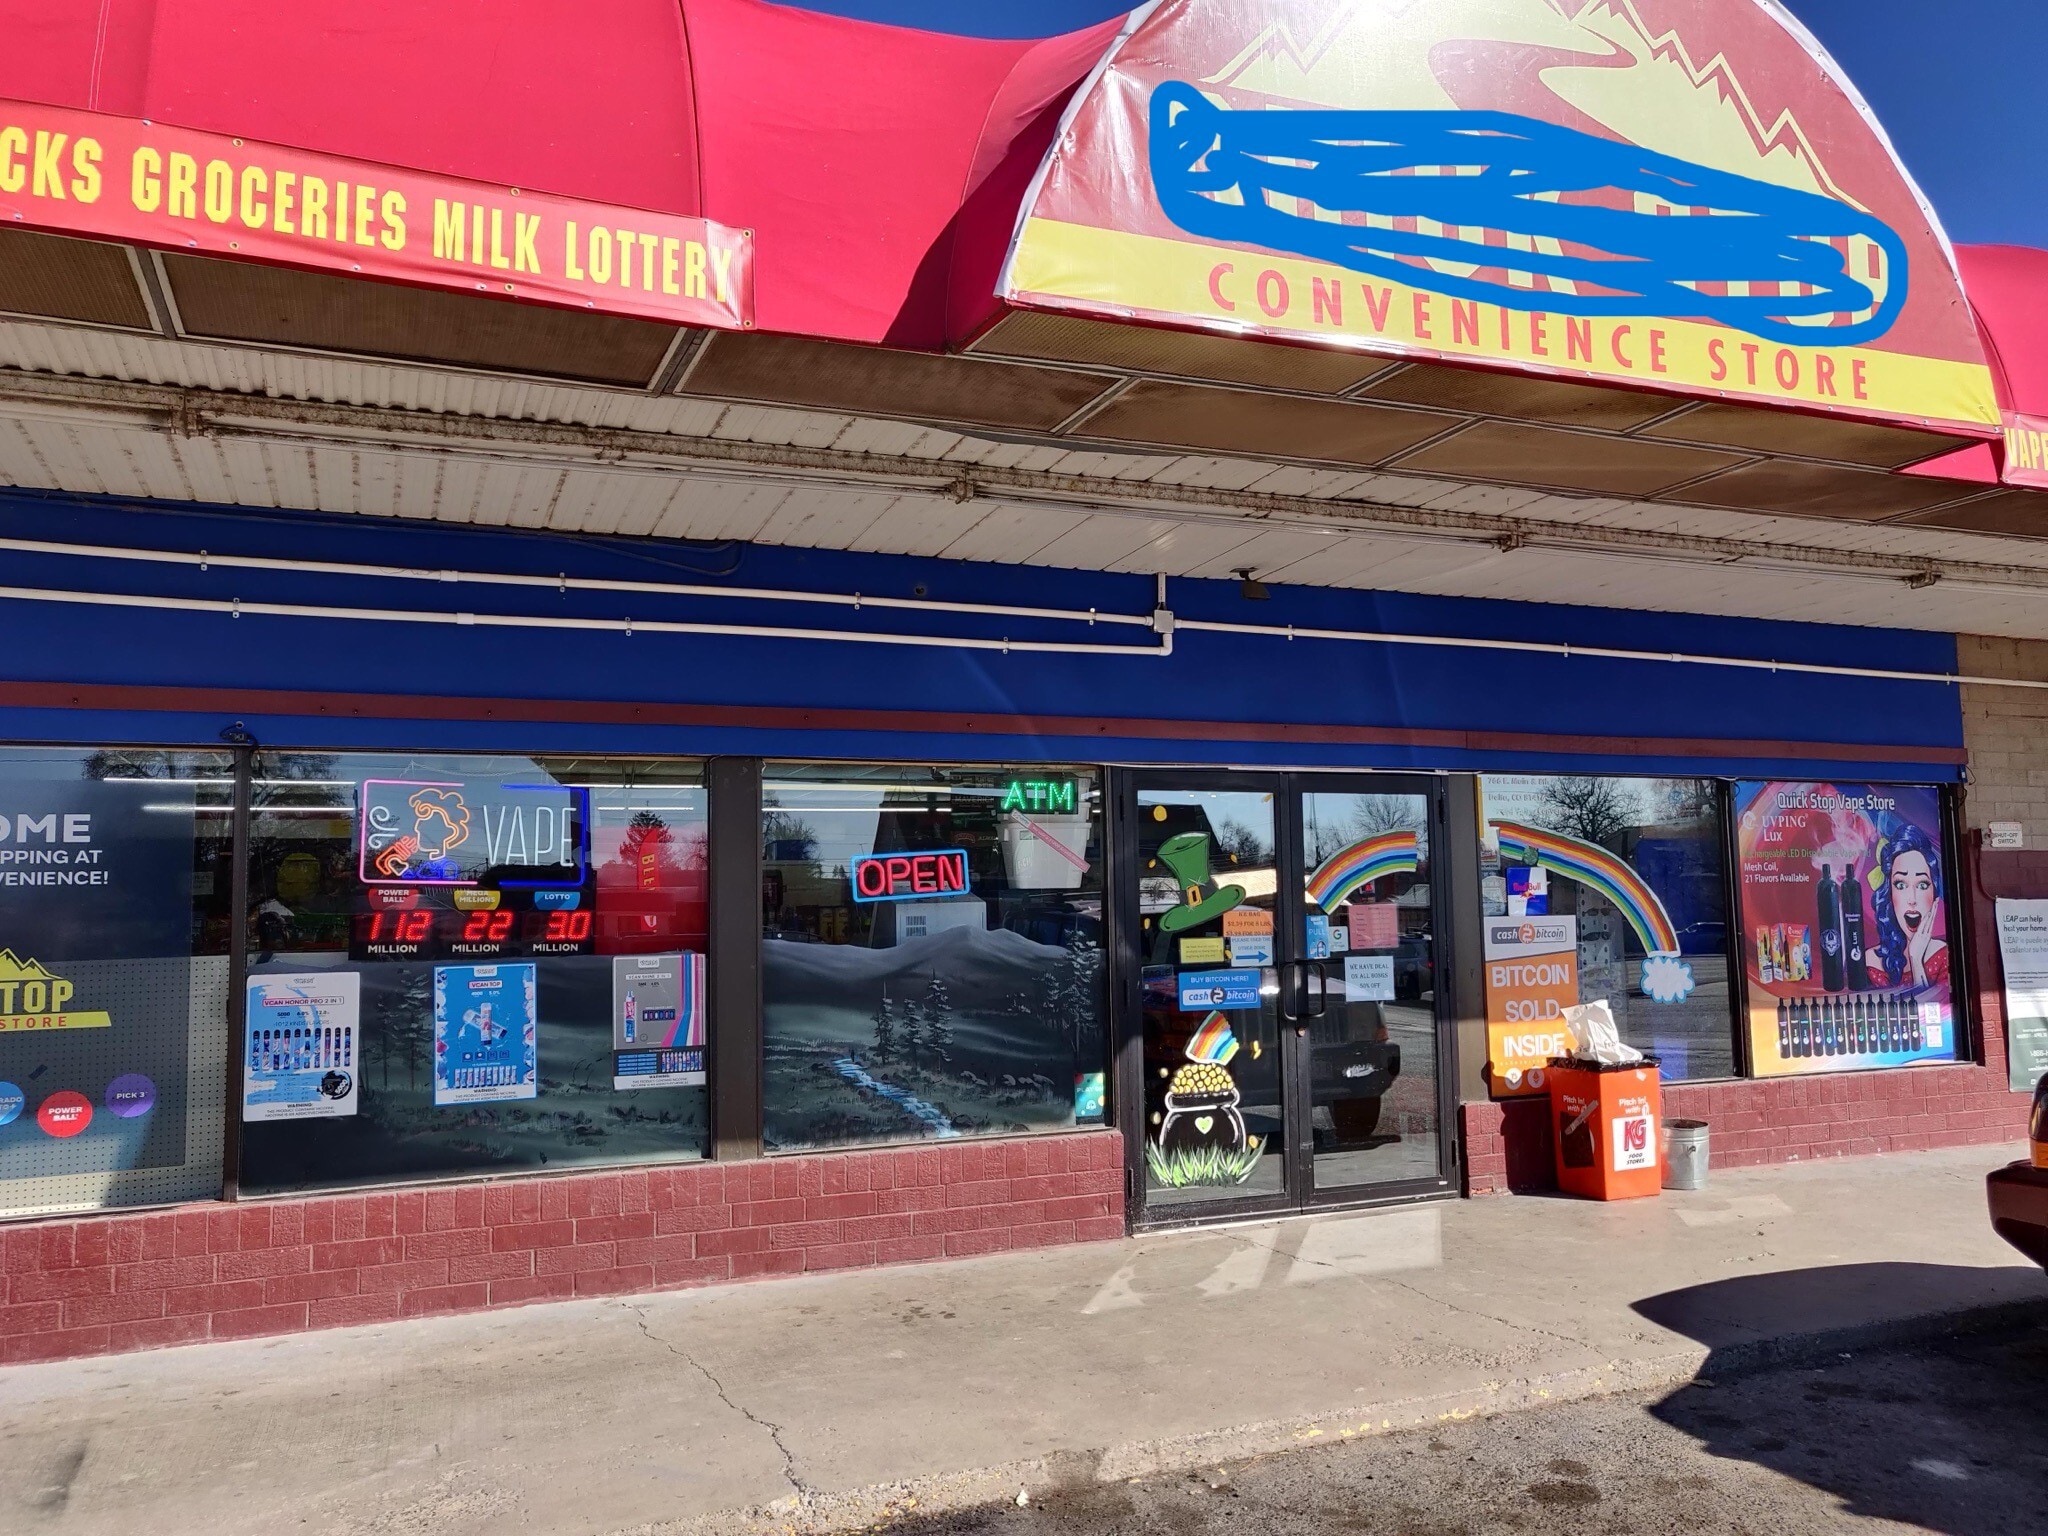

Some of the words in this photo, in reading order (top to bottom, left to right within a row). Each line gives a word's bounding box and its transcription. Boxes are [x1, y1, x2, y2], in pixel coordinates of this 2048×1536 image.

[0, 125, 102, 205] CKS
[132, 145, 407, 251] GROCERIES
[433, 199, 541, 274] MILK
[565, 220, 733, 302] LOTTERY
[1207, 262, 1668, 372] CONVENIENCE
[1710, 338, 1868, 399] STORE
[1003, 780, 1073, 811] ATM
[1777, 792, 1809, 810] Quick
[1810, 793, 1836, 812] Stop
[1837, 794, 1865, 814] Vape
[1867, 794, 1896, 811] Store
[483, 804, 577, 867] VAPE
[1764, 829, 1783, 842] Lux
[74, 850, 103, 864] AT
[1787, 849, 1800, 857] LED
[1744, 863, 1762, 871] Mesh
[1763, 862, 1779, 871] Coil,
[858, 854, 963, 896] OPEN
[1745, 874, 1753, 883] 21
[1754, 874, 1779, 882] Flavors
[1779, 873, 1810, 882] Available
[1512, 882, 1529, 891] Red
[1529, 882, 1542, 891] Bull
[2003, 914, 2019, 922] LEAP
[2029, 914, 2044, 924] help
[370, 911, 432, 941] 112
[464, 910, 513, 941] 22
[546, 910, 592, 941] 30
[2003, 924, 2015, 932] heat
[2016, 926, 2029, 934] your
[2029, 924, 2047, 932] home
[1308, 928, 1326, 936] PULL
[1496, 928, 1518, 940] cash
[1536, 928, 1564, 939] bitcoin
[367, 944, 418, 954] MILLION
[452, 944, 500, 953] MILLION
[532, 943, 579, 952] MILLION
[1491, 963, 1570, 988] BITCOIN
[1188, 991, 1209, 1001] cash
[1226, 990, 1255, 1000] bitcoin
[1505, 998, 1560, 1023] SOLD
[0, 1016, 67, 1030] STORE
[1503, 1033, 1565, 1058] INSIDE
[1562, 1095, 1577, 1104] Pitch
[1619, 1098, 1637, 1107] Pitch
[48, 1106, 83, 1115] POWER
[1567, 1105, 1580, 1113] with
[1625, 1107, 1641, 1115] with
[53, 1114, 78, 1122] BALL
[1624, 1119, 1646, 1151] KG
